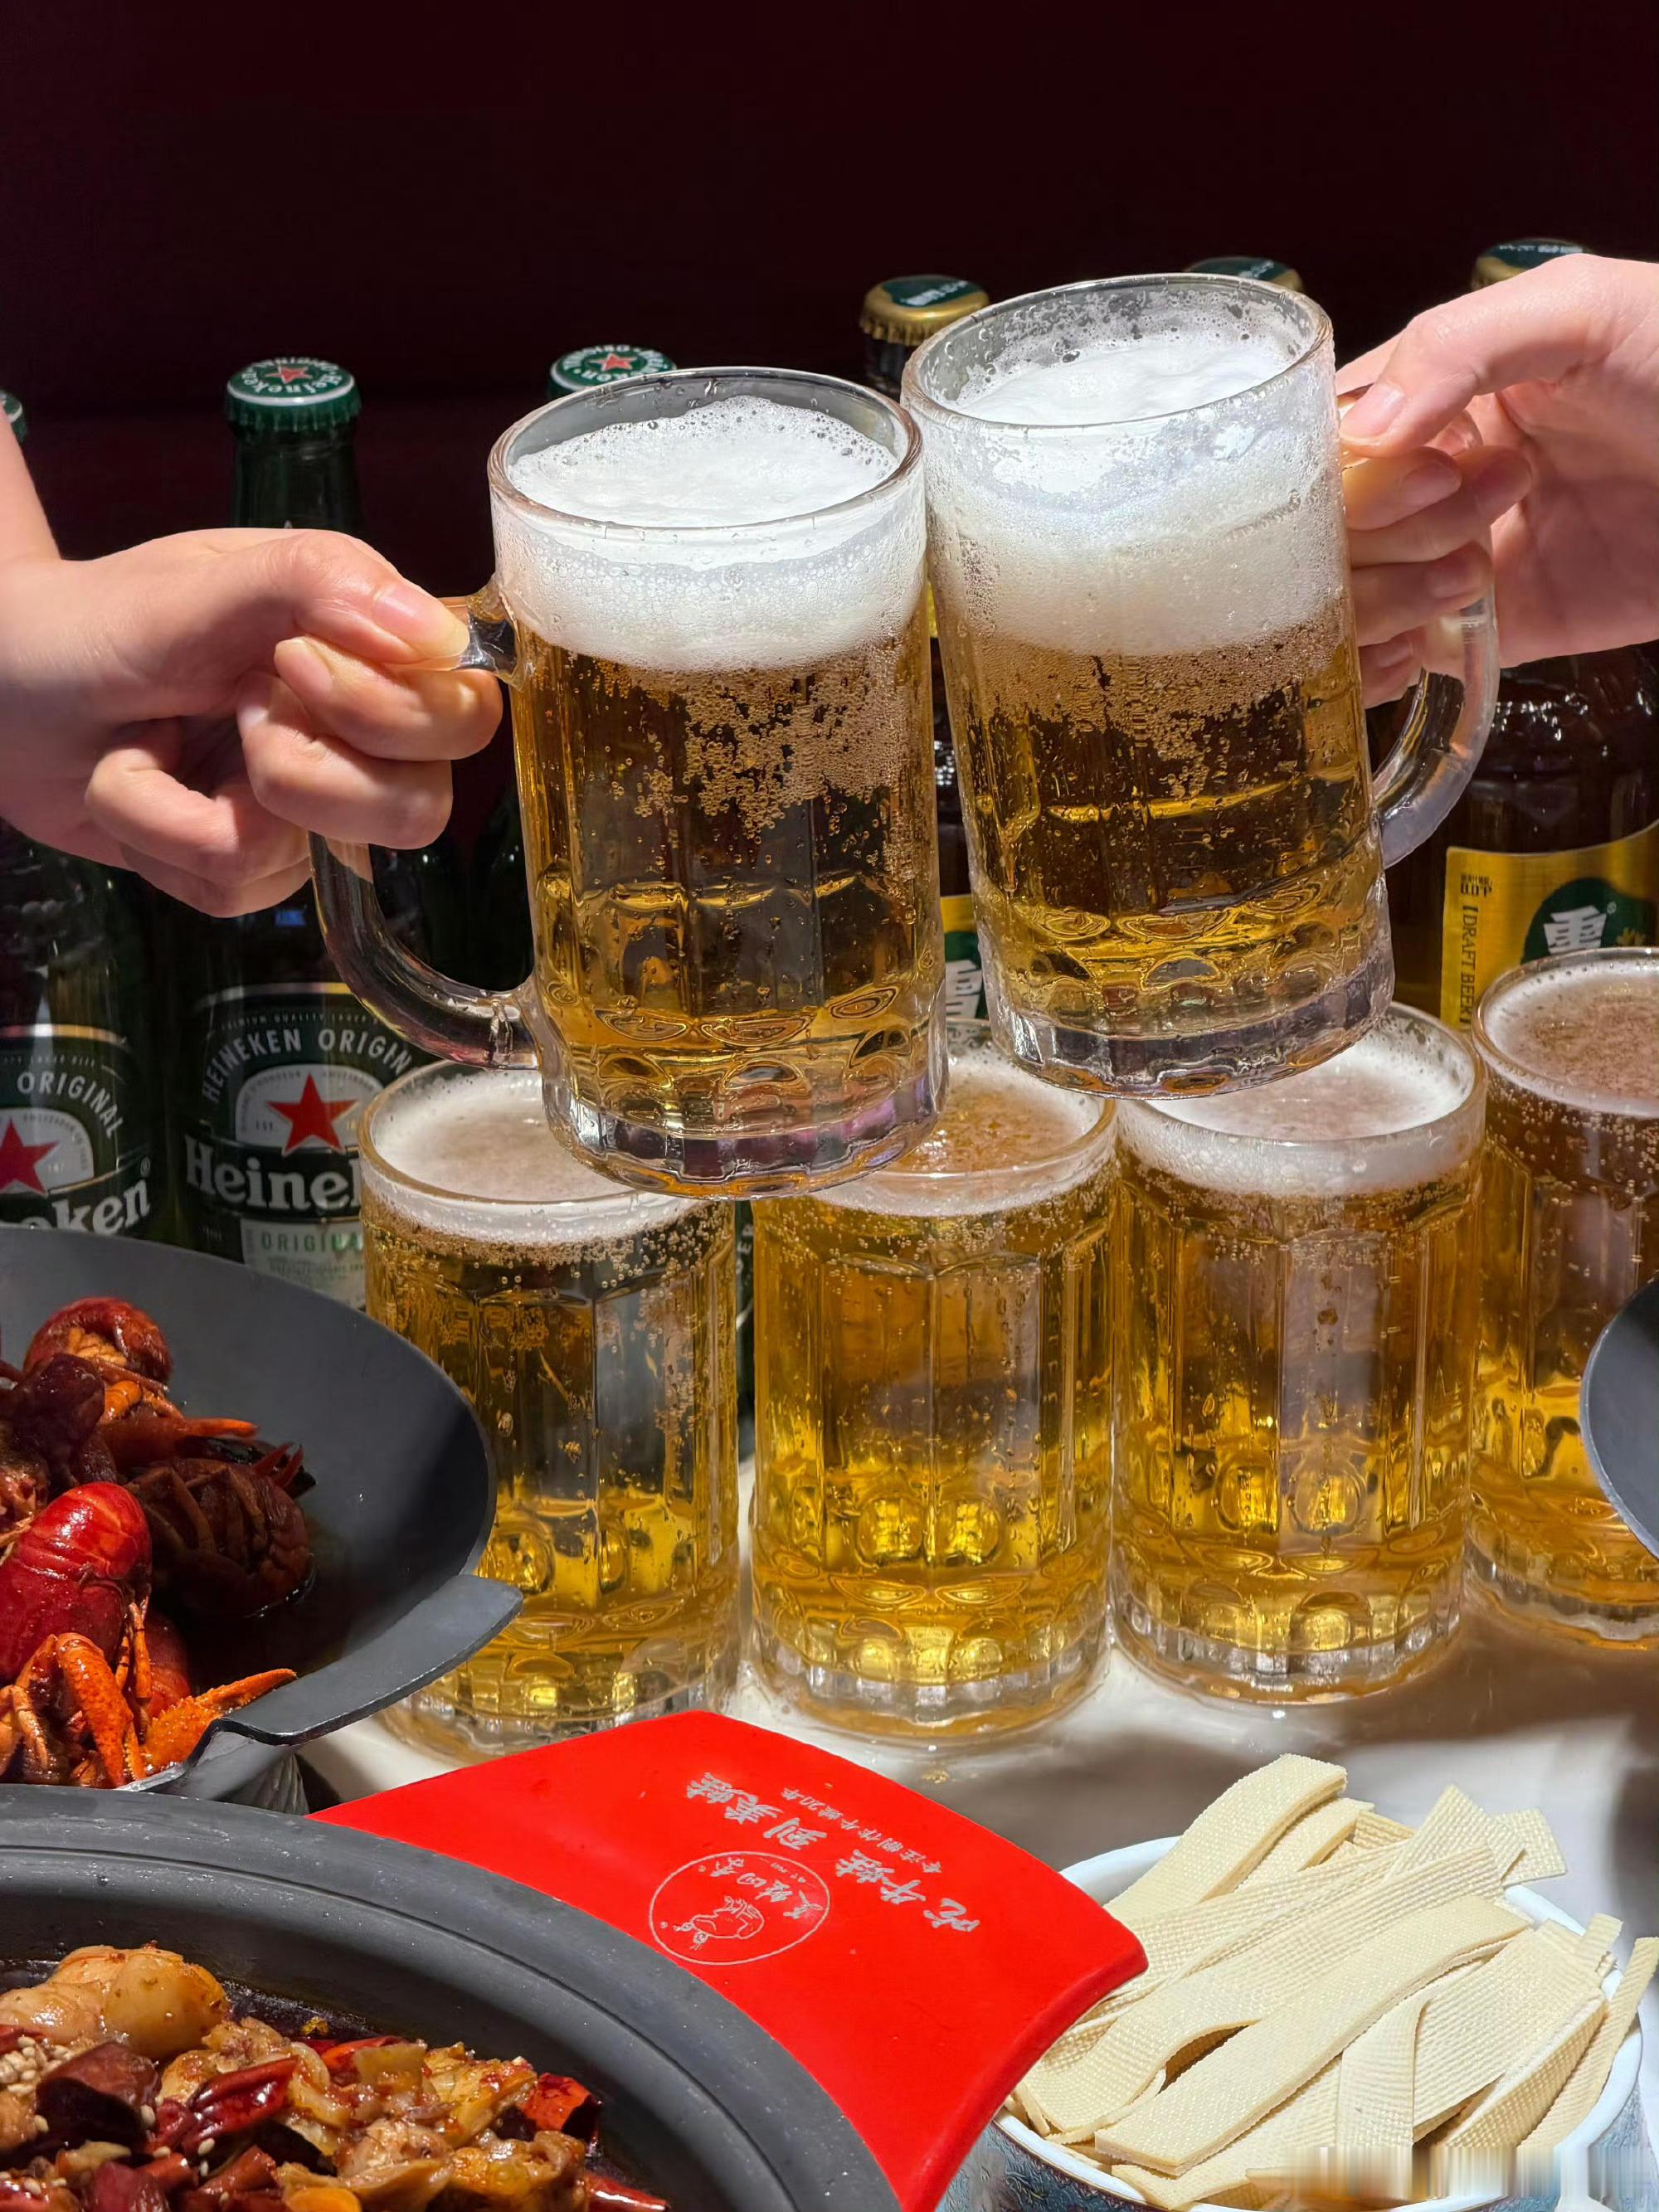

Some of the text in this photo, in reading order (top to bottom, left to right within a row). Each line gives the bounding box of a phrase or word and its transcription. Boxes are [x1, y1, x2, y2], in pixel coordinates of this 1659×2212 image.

[202, 1028, 302, 1103] HEINEKEN
[318, 1028, 413, 1077] ORIGIN
[17, 1069, 125, 1140] ORIGINAL
[261, 1232, 363, 1254] ORIGINA
[686, 1772, 980, 1932] 吃牛蛙 到美蛙
